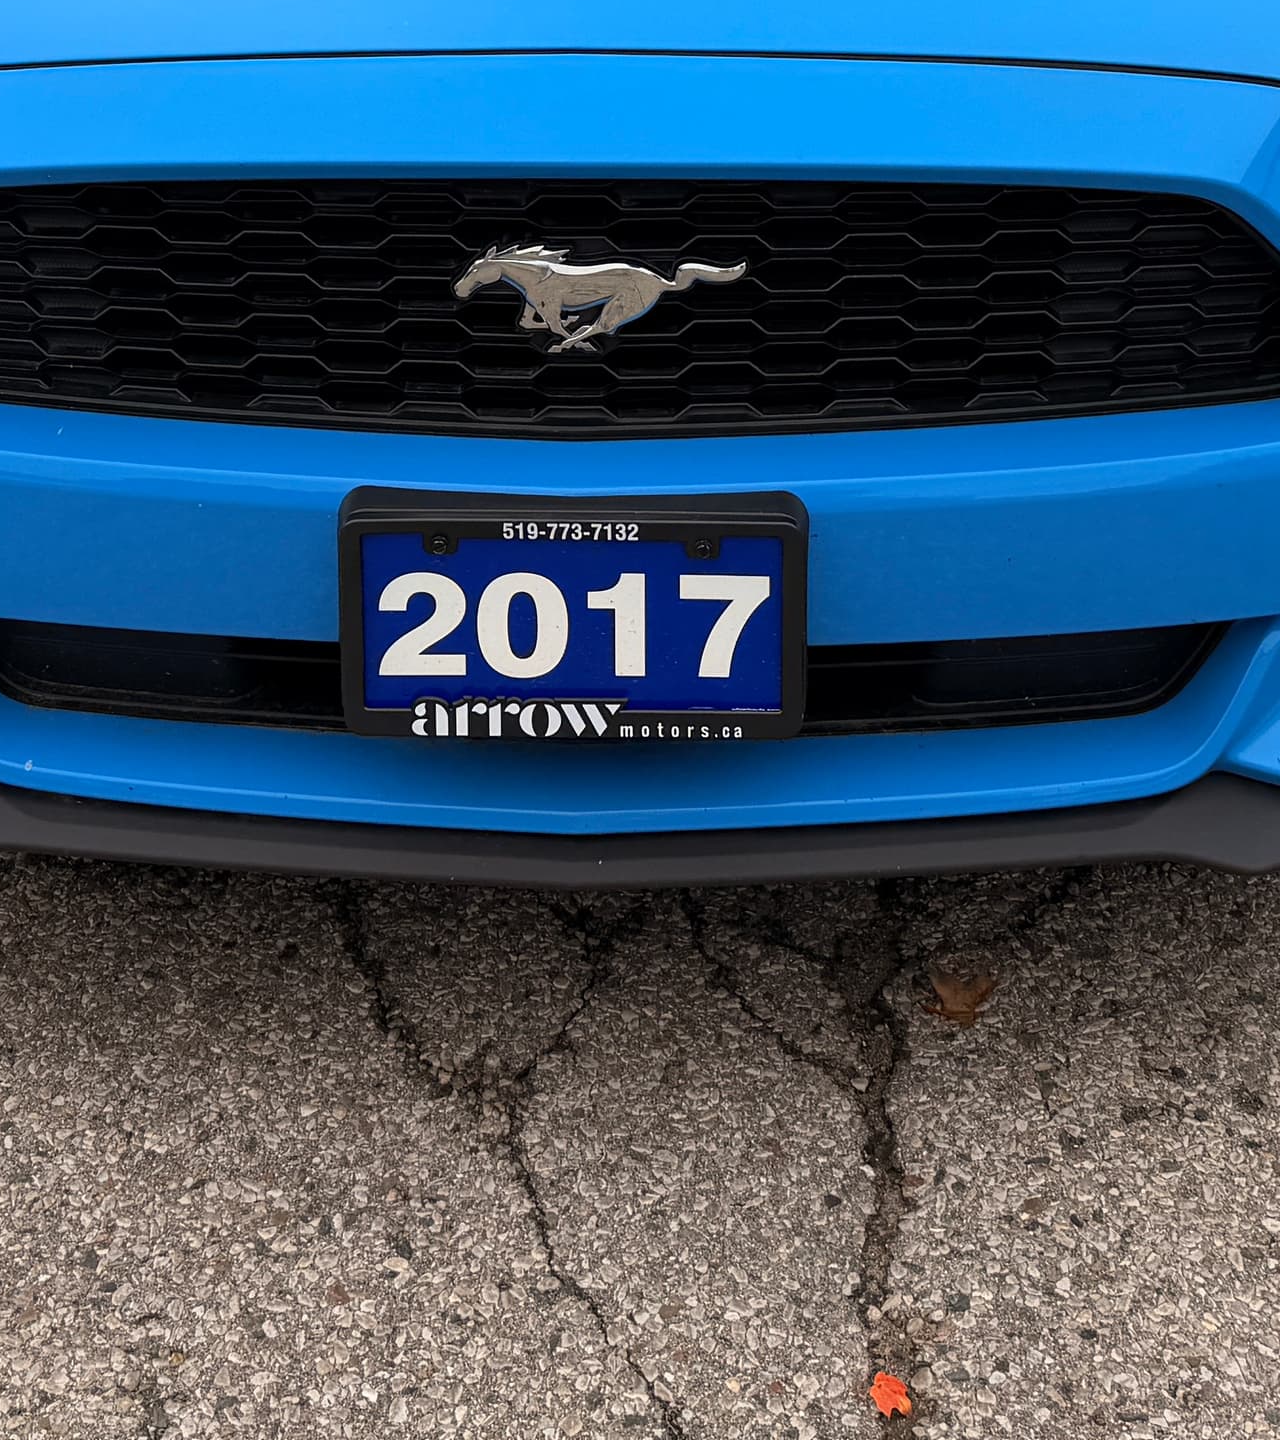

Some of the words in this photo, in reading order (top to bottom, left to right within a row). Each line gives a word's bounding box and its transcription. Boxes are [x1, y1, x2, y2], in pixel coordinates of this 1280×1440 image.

[502, 522, 639, 541] 519-773-7132
[378, 572, 770, 678] 2017
[411, 702, 621, 737] arrow
[620, 722, 743, 738] motors.ca
